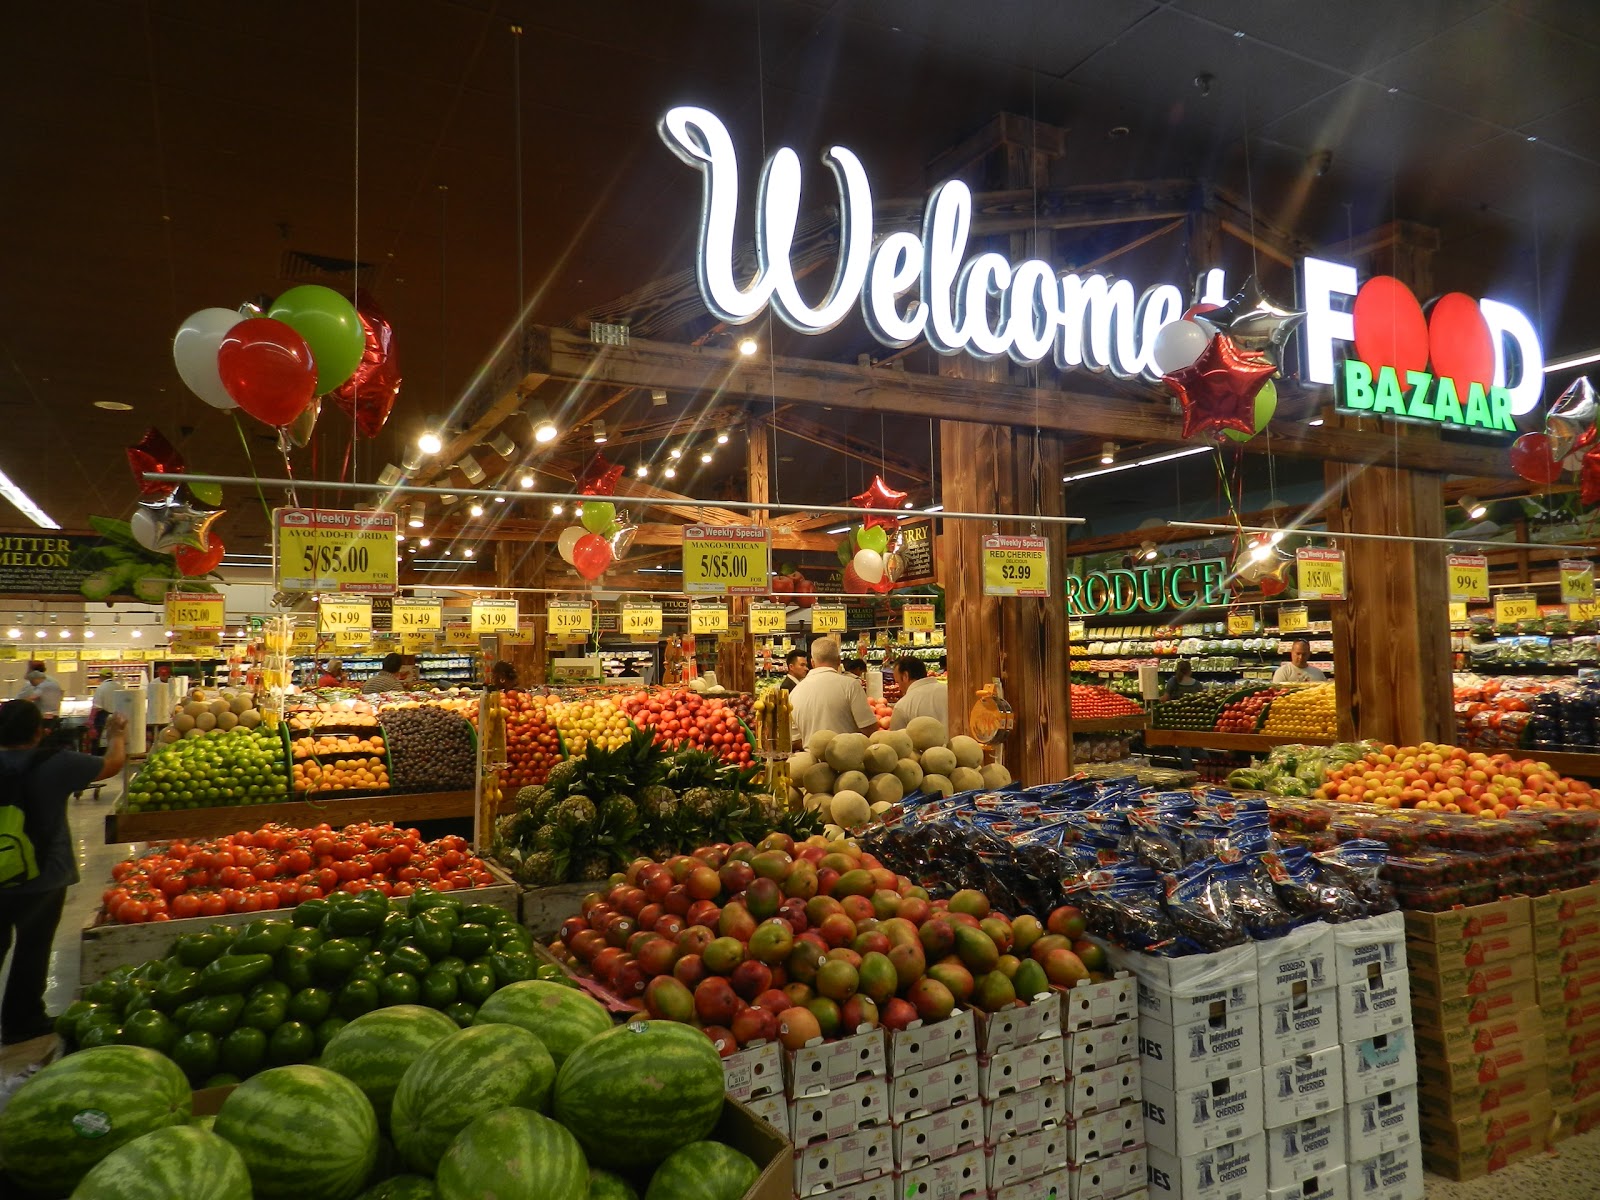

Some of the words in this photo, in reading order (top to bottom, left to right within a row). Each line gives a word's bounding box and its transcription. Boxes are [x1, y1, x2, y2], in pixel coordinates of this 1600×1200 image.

[656, 105, 1183, 383] Welcome
[1304, 257, 1544, 416] FOOD
[1345, 360, 1517, 431] BAZAAR
[312, 512, 350, 526] Weekly
[354, 514, 393, 526] Special
[288, 530, 389, 541] AVOCADO-FLORIDA
[705, 527, 734, 538] Weekly
[736, 529, 764, 538] Special
[0, 537, 72, 552] ITTER
[1001, 539, 1022, 548] Weekly
[1023, 540, 1044, 548] Special
[304, 545, 369, 573] 5/$5.00
[701, 554, 747, 578] 5/$5.00
[1002, 565, 1031, 580] $2.99
[1066, 557, 1231, 616] RODUCE
[1457, 575, 1478, 589] 99¢
[373, 600, 391, 608] AVA
[1504, 606, 1527, 616] $3.99
[331, 612, 359, 624] $1.99
[403, 613, 430, 625] $1.49
[481, 613, 506, 625] $1.99
[558, 615, 582, 626] $1.99
[631, 616, 653, 626] $1.49
[699, 616, 720, 627] $1.49
[758, 616, 779, 627] $1.49
[820, 617, 838, 626] $1.99
[292, 632, 308, 640] 1.99
[343, 632, 364, 640] $1.99
[1209, 1027, 1243, 1045] Independent
[1139, 1036, 1163, 1060] IES
[1212, 1039, 1240, 1053] CHERRIES
[1296, 1067, 1327, 1085] Independent
[1299, 1079, 1325, 1093] CHERRIES
[1213, 1090, 1247, 1109] Independent
[1142, 1100, 1166, 1125] IES
[1216, 1103, 1244, 1118] CHERRIES
[1304, 1137, 1329, 1152] CHERRIES
[1217, 1153, 1250, 1174] Independent
[1147, 1165, 1171, 1191] IES
[1220, 1166, 1247, 1182] CHERRIES
[1383, 1172, 1407, 1186] CHERRIES
